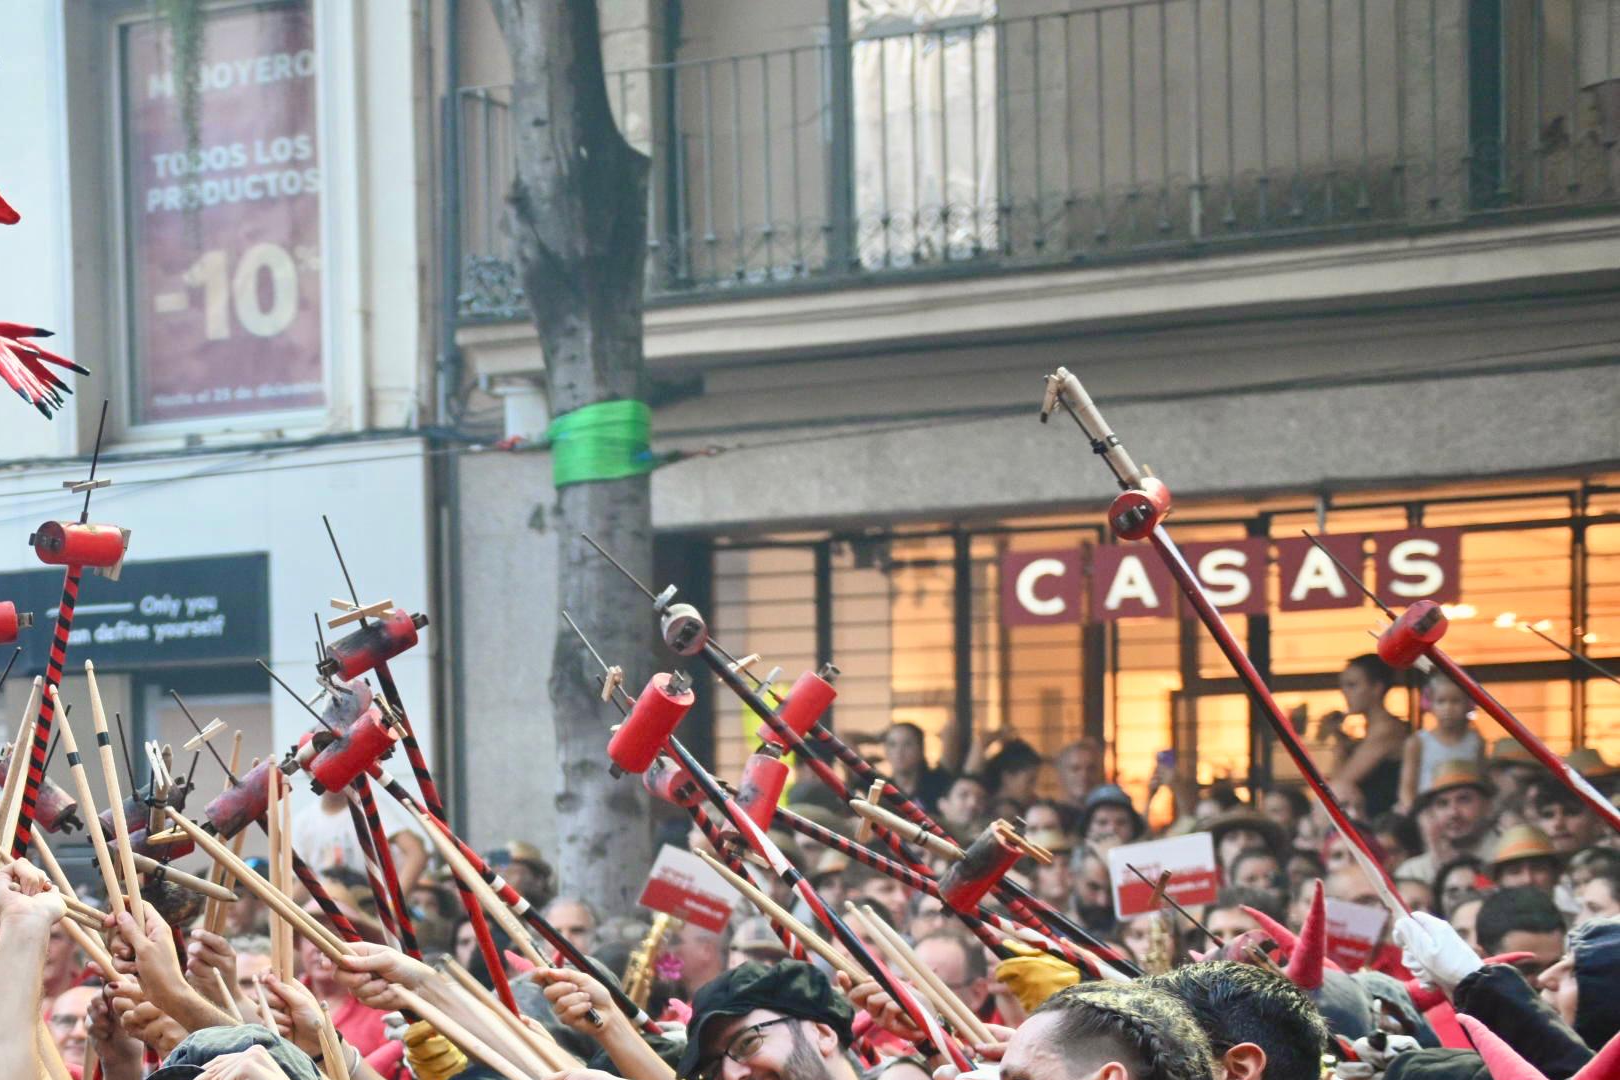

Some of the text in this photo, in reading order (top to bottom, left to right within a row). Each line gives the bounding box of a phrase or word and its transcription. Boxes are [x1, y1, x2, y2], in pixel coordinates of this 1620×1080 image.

[197, 50, 317, 93] JOYERO
[253, 134, 312, 166] LOS
[1015, 539, 1444, 616] CASAS
[140, 594, 218, 617] Only you
[94, 620, 150, 643] define
[153, 614, 226, 643] yourself
